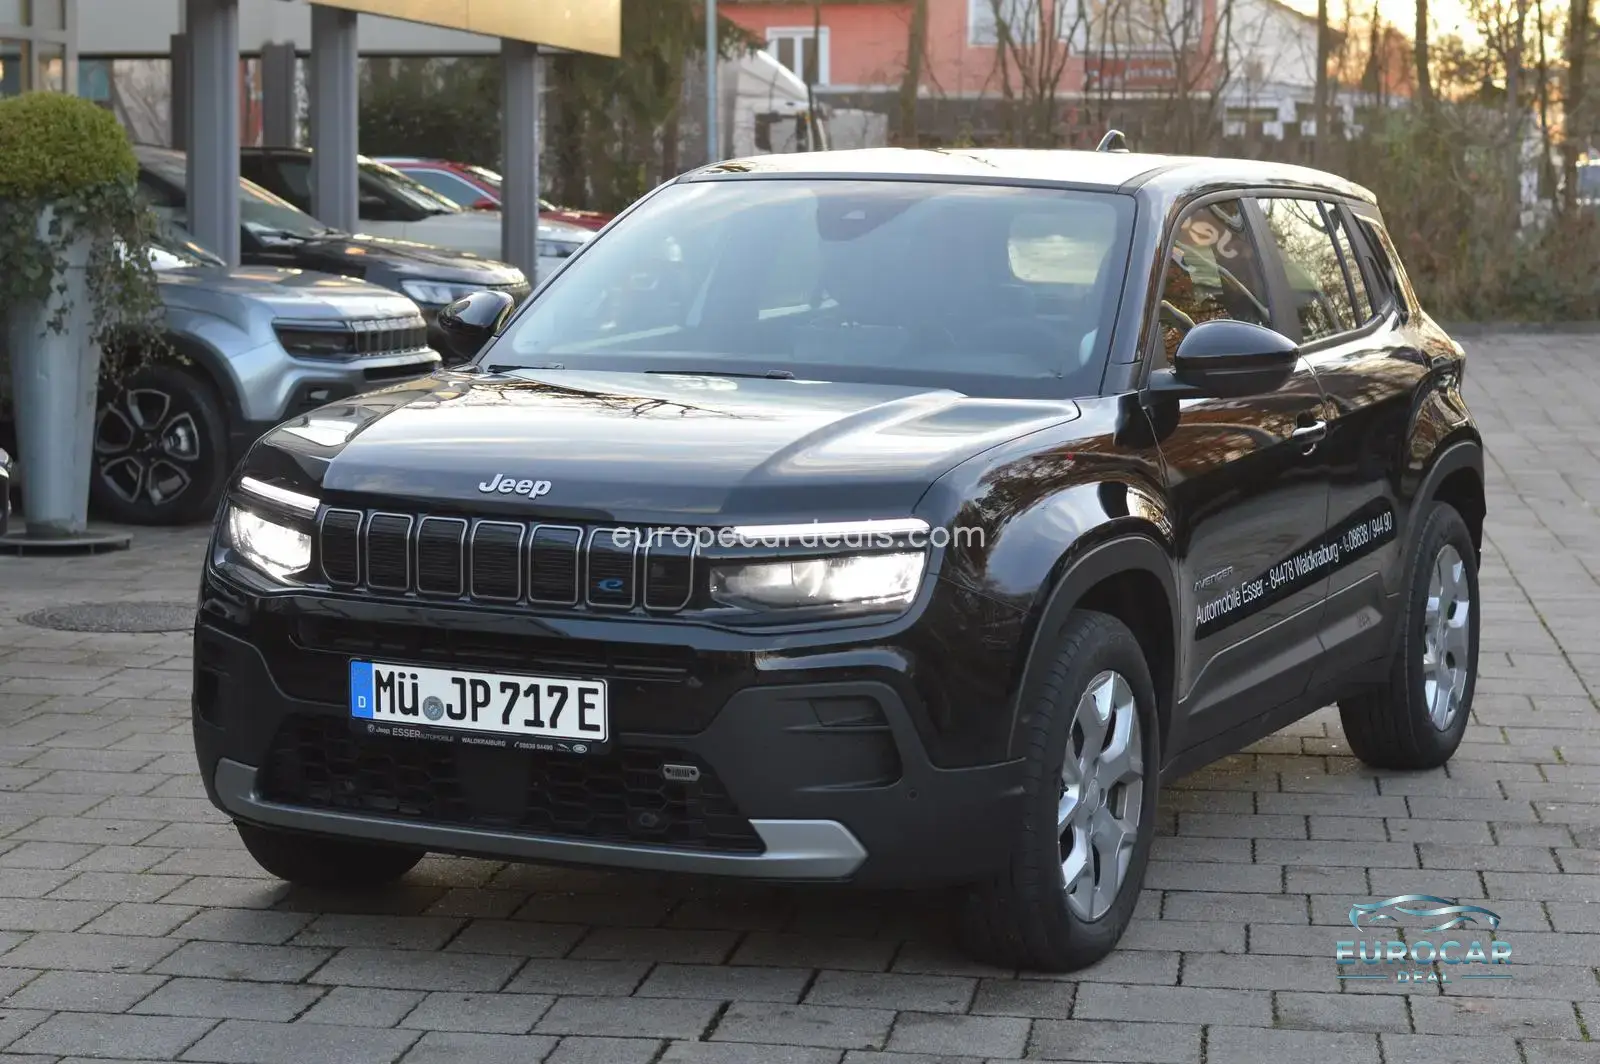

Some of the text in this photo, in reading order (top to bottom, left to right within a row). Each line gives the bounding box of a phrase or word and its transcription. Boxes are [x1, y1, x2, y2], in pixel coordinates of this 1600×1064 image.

[478, 473, 552, 499] Jeep
[1195, 589, 1241, 626] Automobile
[1241, 581, 1265, 603] Esser
[1269, 561, 1295, 589] 84478
[1295, 543, 1340, 576] Waldkraiburg
[357, 695, 366, 709] D
[374, 669, 419, 717] MÜ
[446, 676, 491, 722] JP
[392, 727, 420, 738] ESSER
